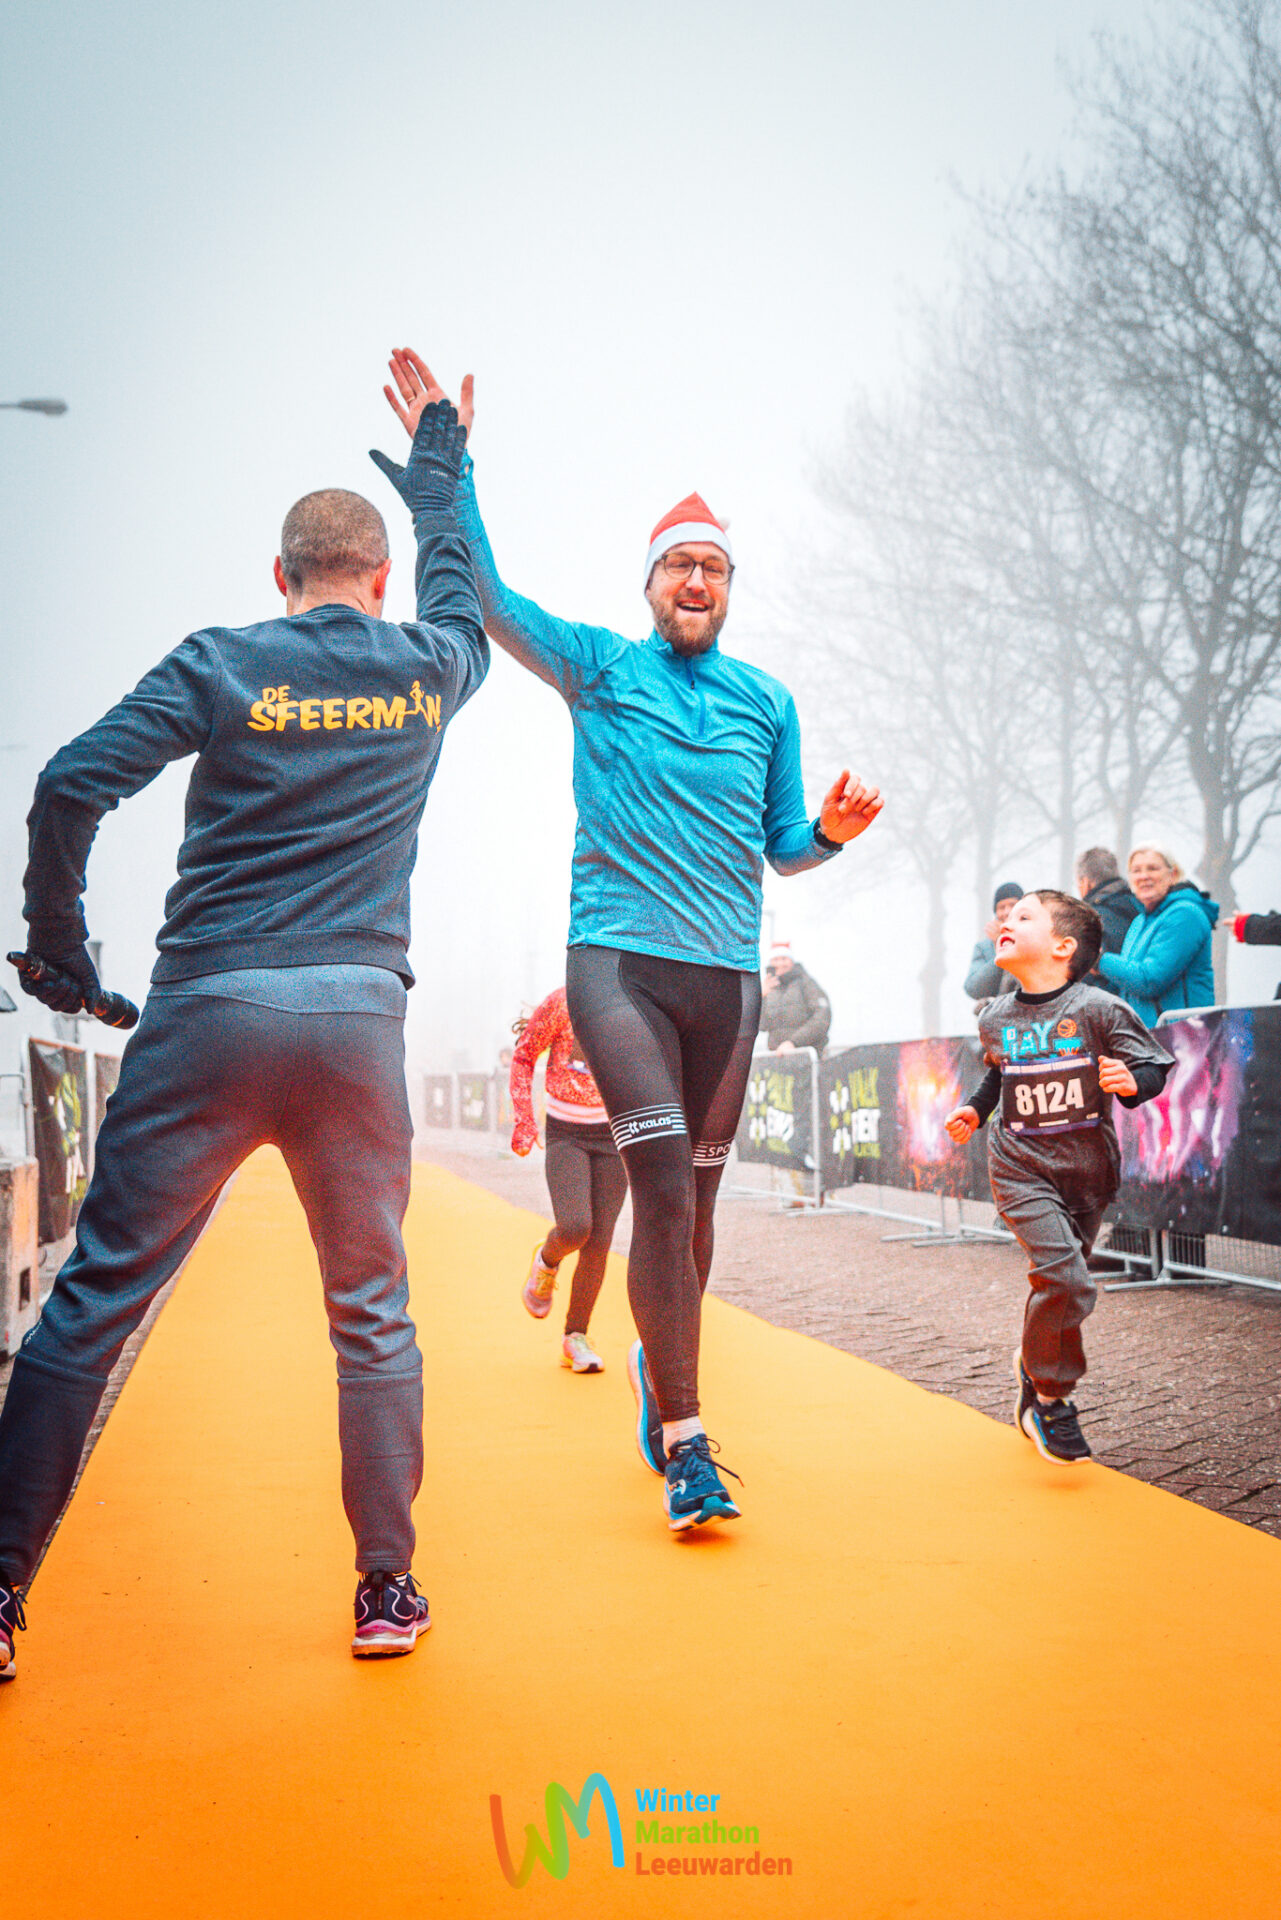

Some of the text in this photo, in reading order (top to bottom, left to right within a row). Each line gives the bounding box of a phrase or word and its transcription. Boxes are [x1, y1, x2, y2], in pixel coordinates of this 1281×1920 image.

[262, 685, 291, 705] DE
[1001, 1020, 1056, 1063] PLAY
[1014, 1077, 1085, 1116] 8124
